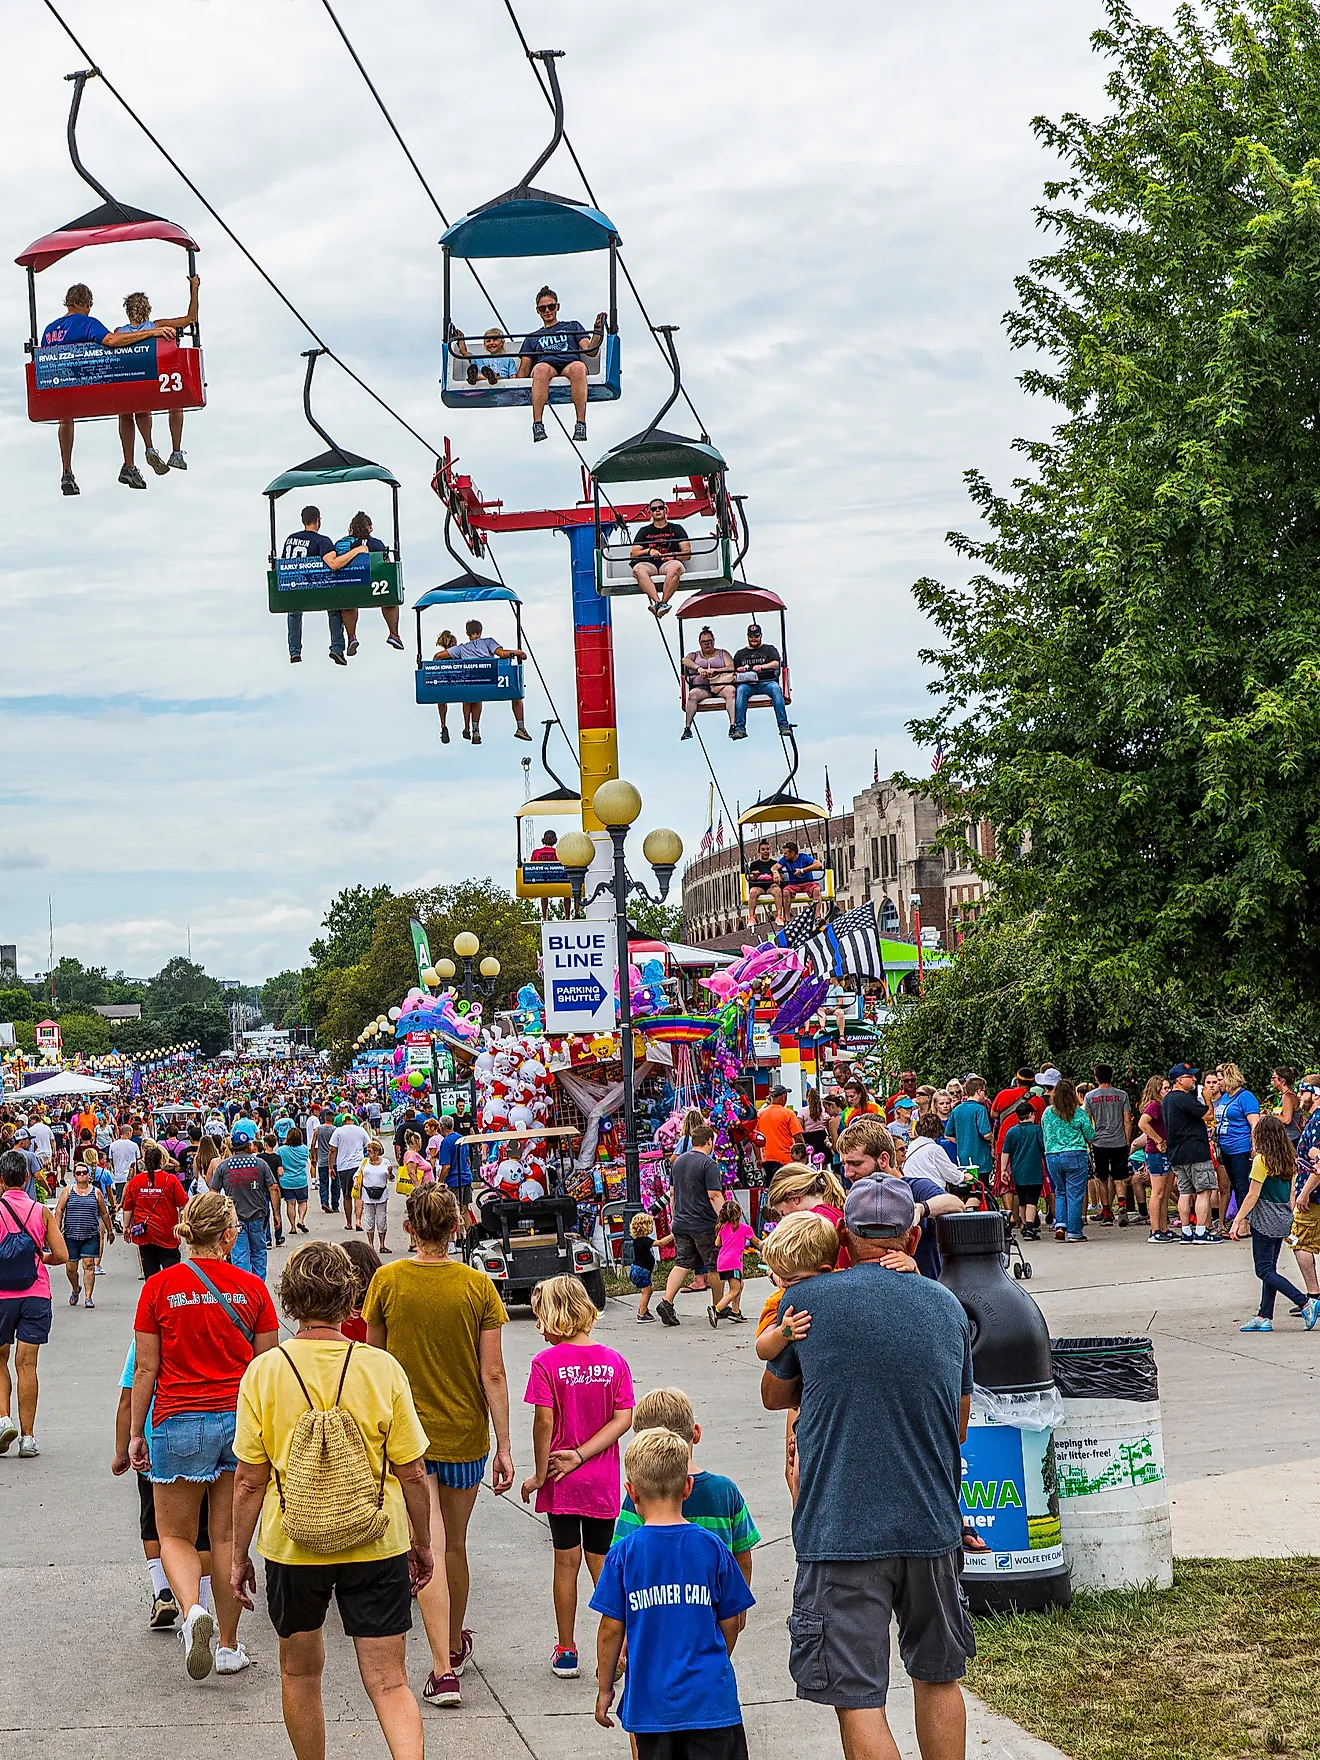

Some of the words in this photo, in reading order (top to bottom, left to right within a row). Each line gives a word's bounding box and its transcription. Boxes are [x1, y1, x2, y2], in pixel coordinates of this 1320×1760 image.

[539, 334, 568, 349] WILD
[39, 354, 58, 362] RIVAL
[84, 349, 103, 357] AMES
[134, 345, 150, 353] CITY
[158, 372, 183, 393] 23
[299, 562, 324, 570] SNOOZE
[371, 580, 389, 596] 22
[497, 675, 509, 687] 21
[549, 934, 606, 950] BLUE
[555, 953, 603, 968] LINE
[557, 986, 600, 995] PARKING
[558, 994, 600, 1003] SHUTTLE
[233, 1293, 247, 1304] are.
[588, 1365, 614, 1377] 1979
[1054, 1439, 1082, 1449] eeping
[1069, 1448, 1111, 1460] litter-free!
[959, 1480, 1023, 1510] WA
[1015, 1555, 1040, 1564] WOLFE
[1041, 1553, 1051, 1562] EYE
[628, 1584, 680, 1611] SUMMER
[684, 1584, 712, 1606] CAM
